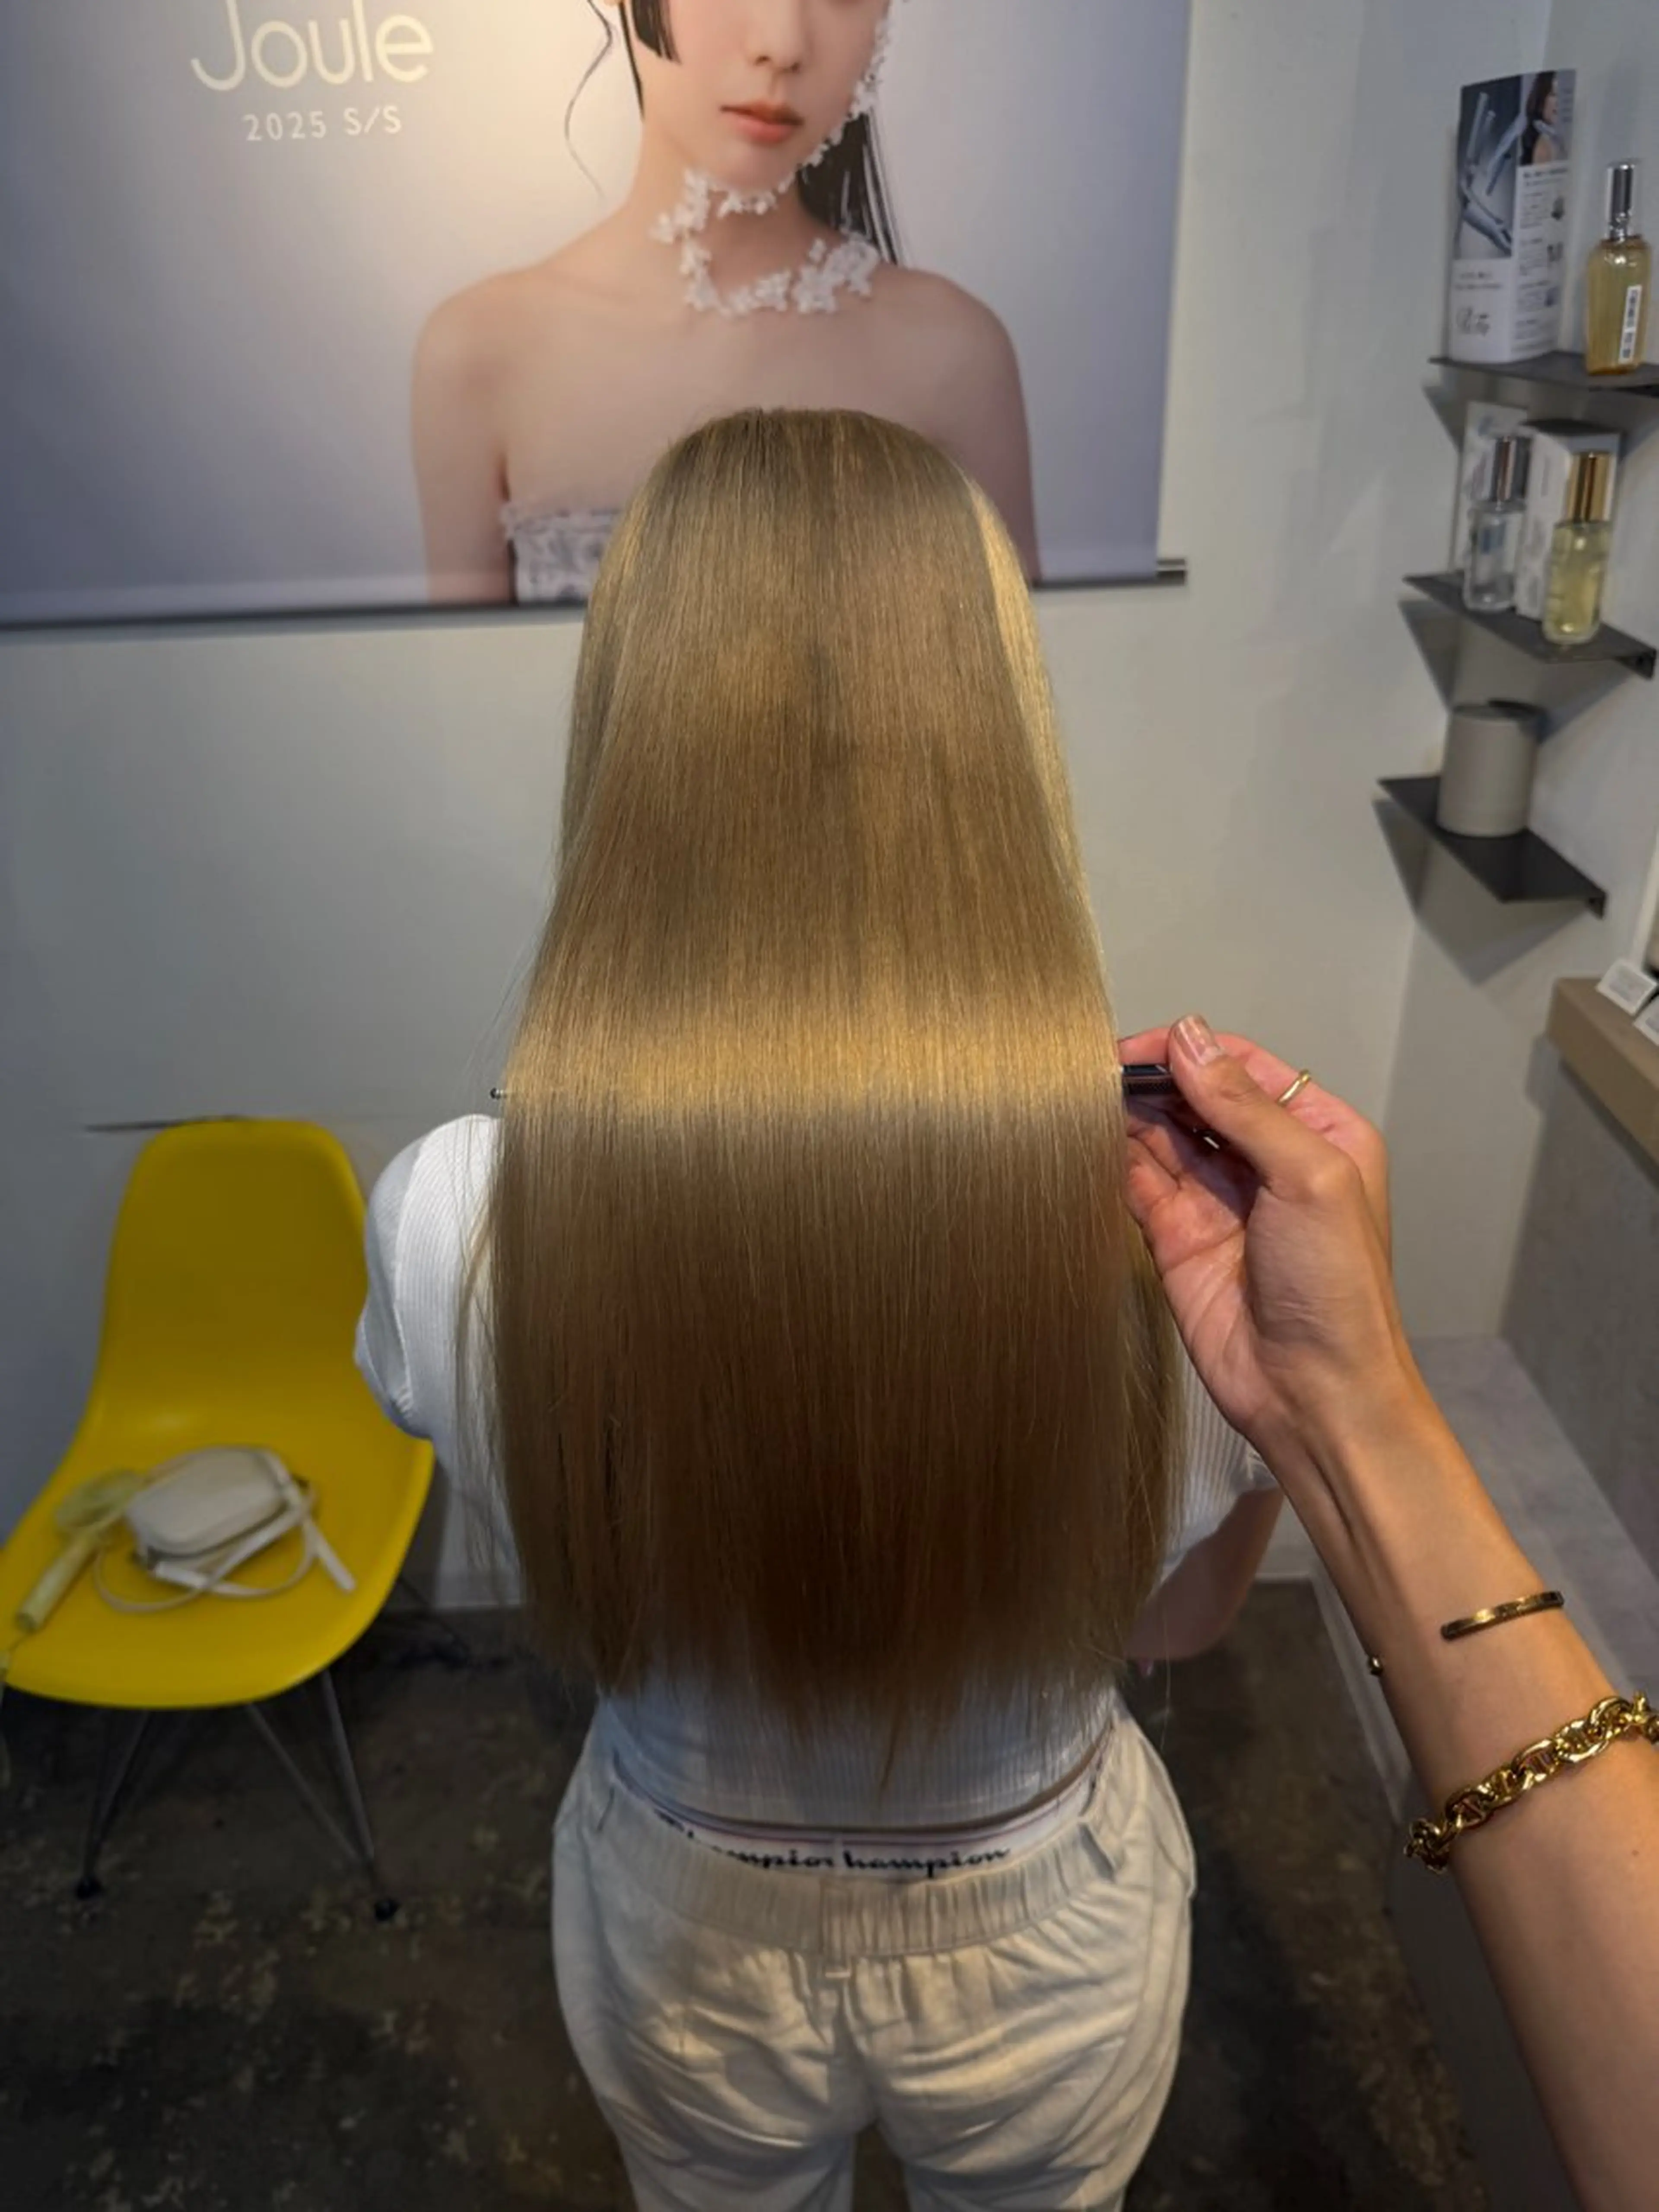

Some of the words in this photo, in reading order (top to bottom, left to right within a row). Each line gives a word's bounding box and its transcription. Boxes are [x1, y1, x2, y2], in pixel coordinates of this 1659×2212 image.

[191, 0, 433, 90] Joule
[243, 111, 327, 141] 2025
[343, 105, 402, 135] S/S
